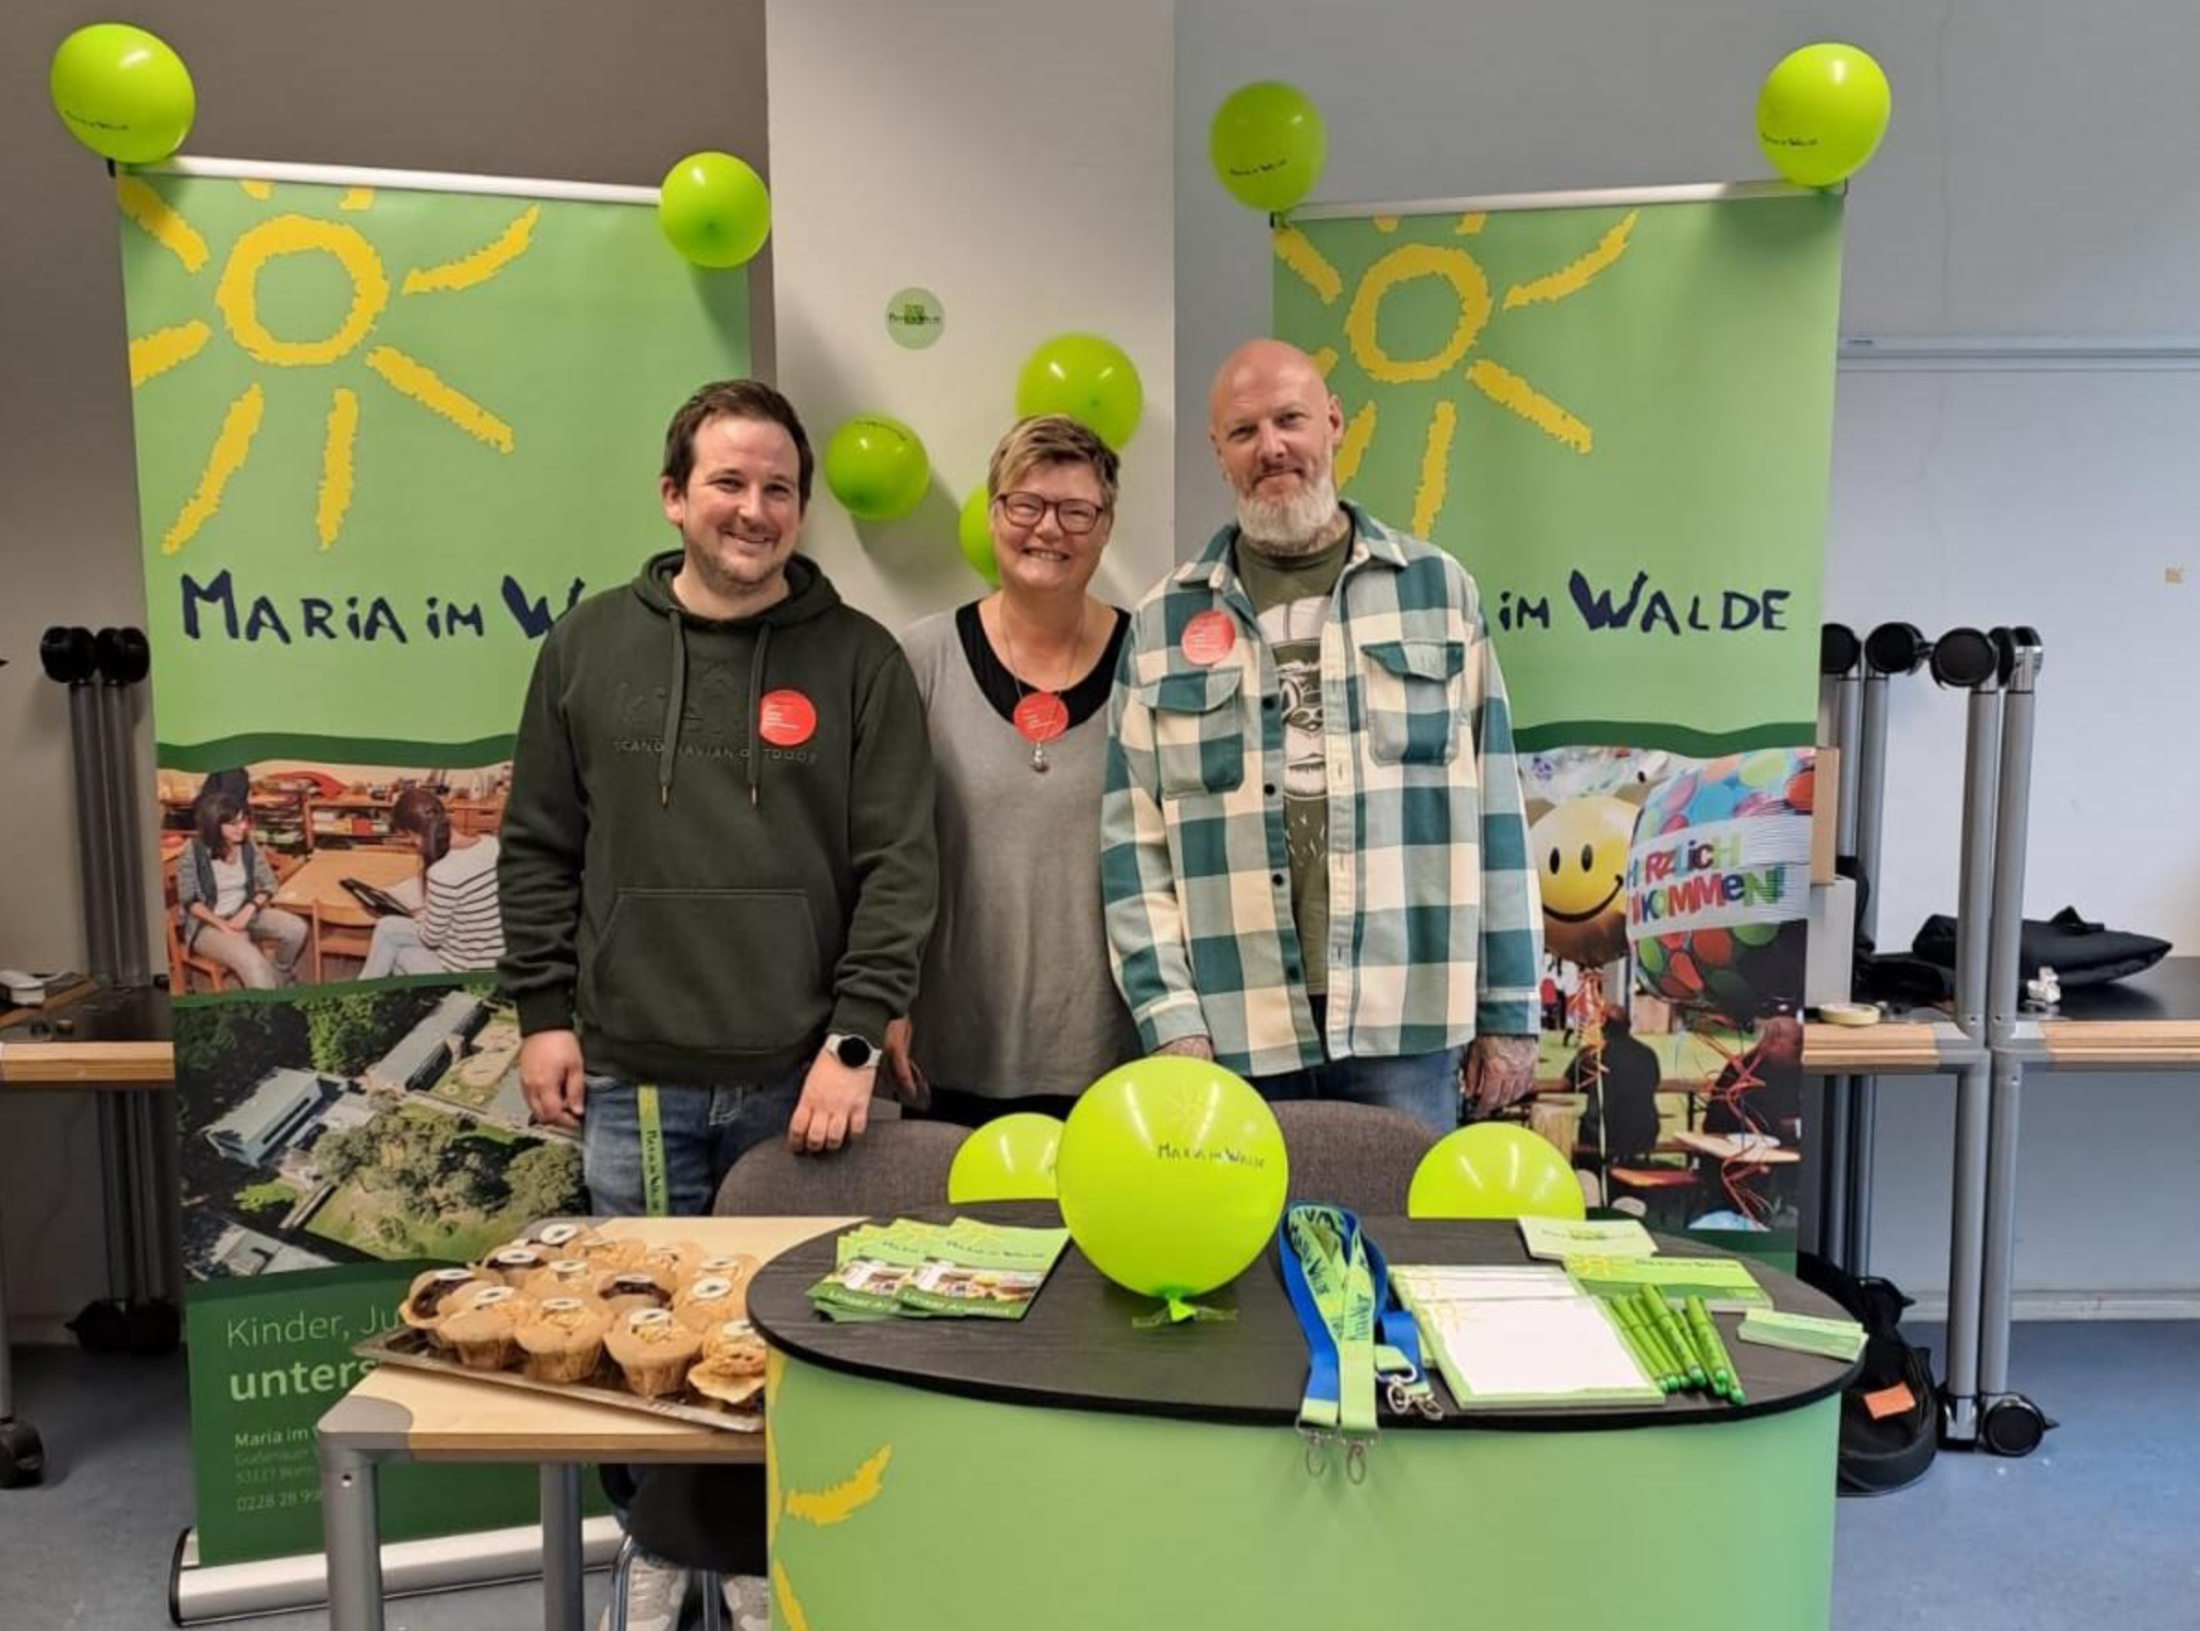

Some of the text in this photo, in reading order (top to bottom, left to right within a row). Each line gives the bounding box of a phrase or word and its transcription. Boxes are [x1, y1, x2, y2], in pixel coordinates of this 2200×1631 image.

[1568, 569, 1791, 635] WALDE
[227, 1309, 350, 1349] Kinder,
[235, 1428, 283, 1449] Maria
